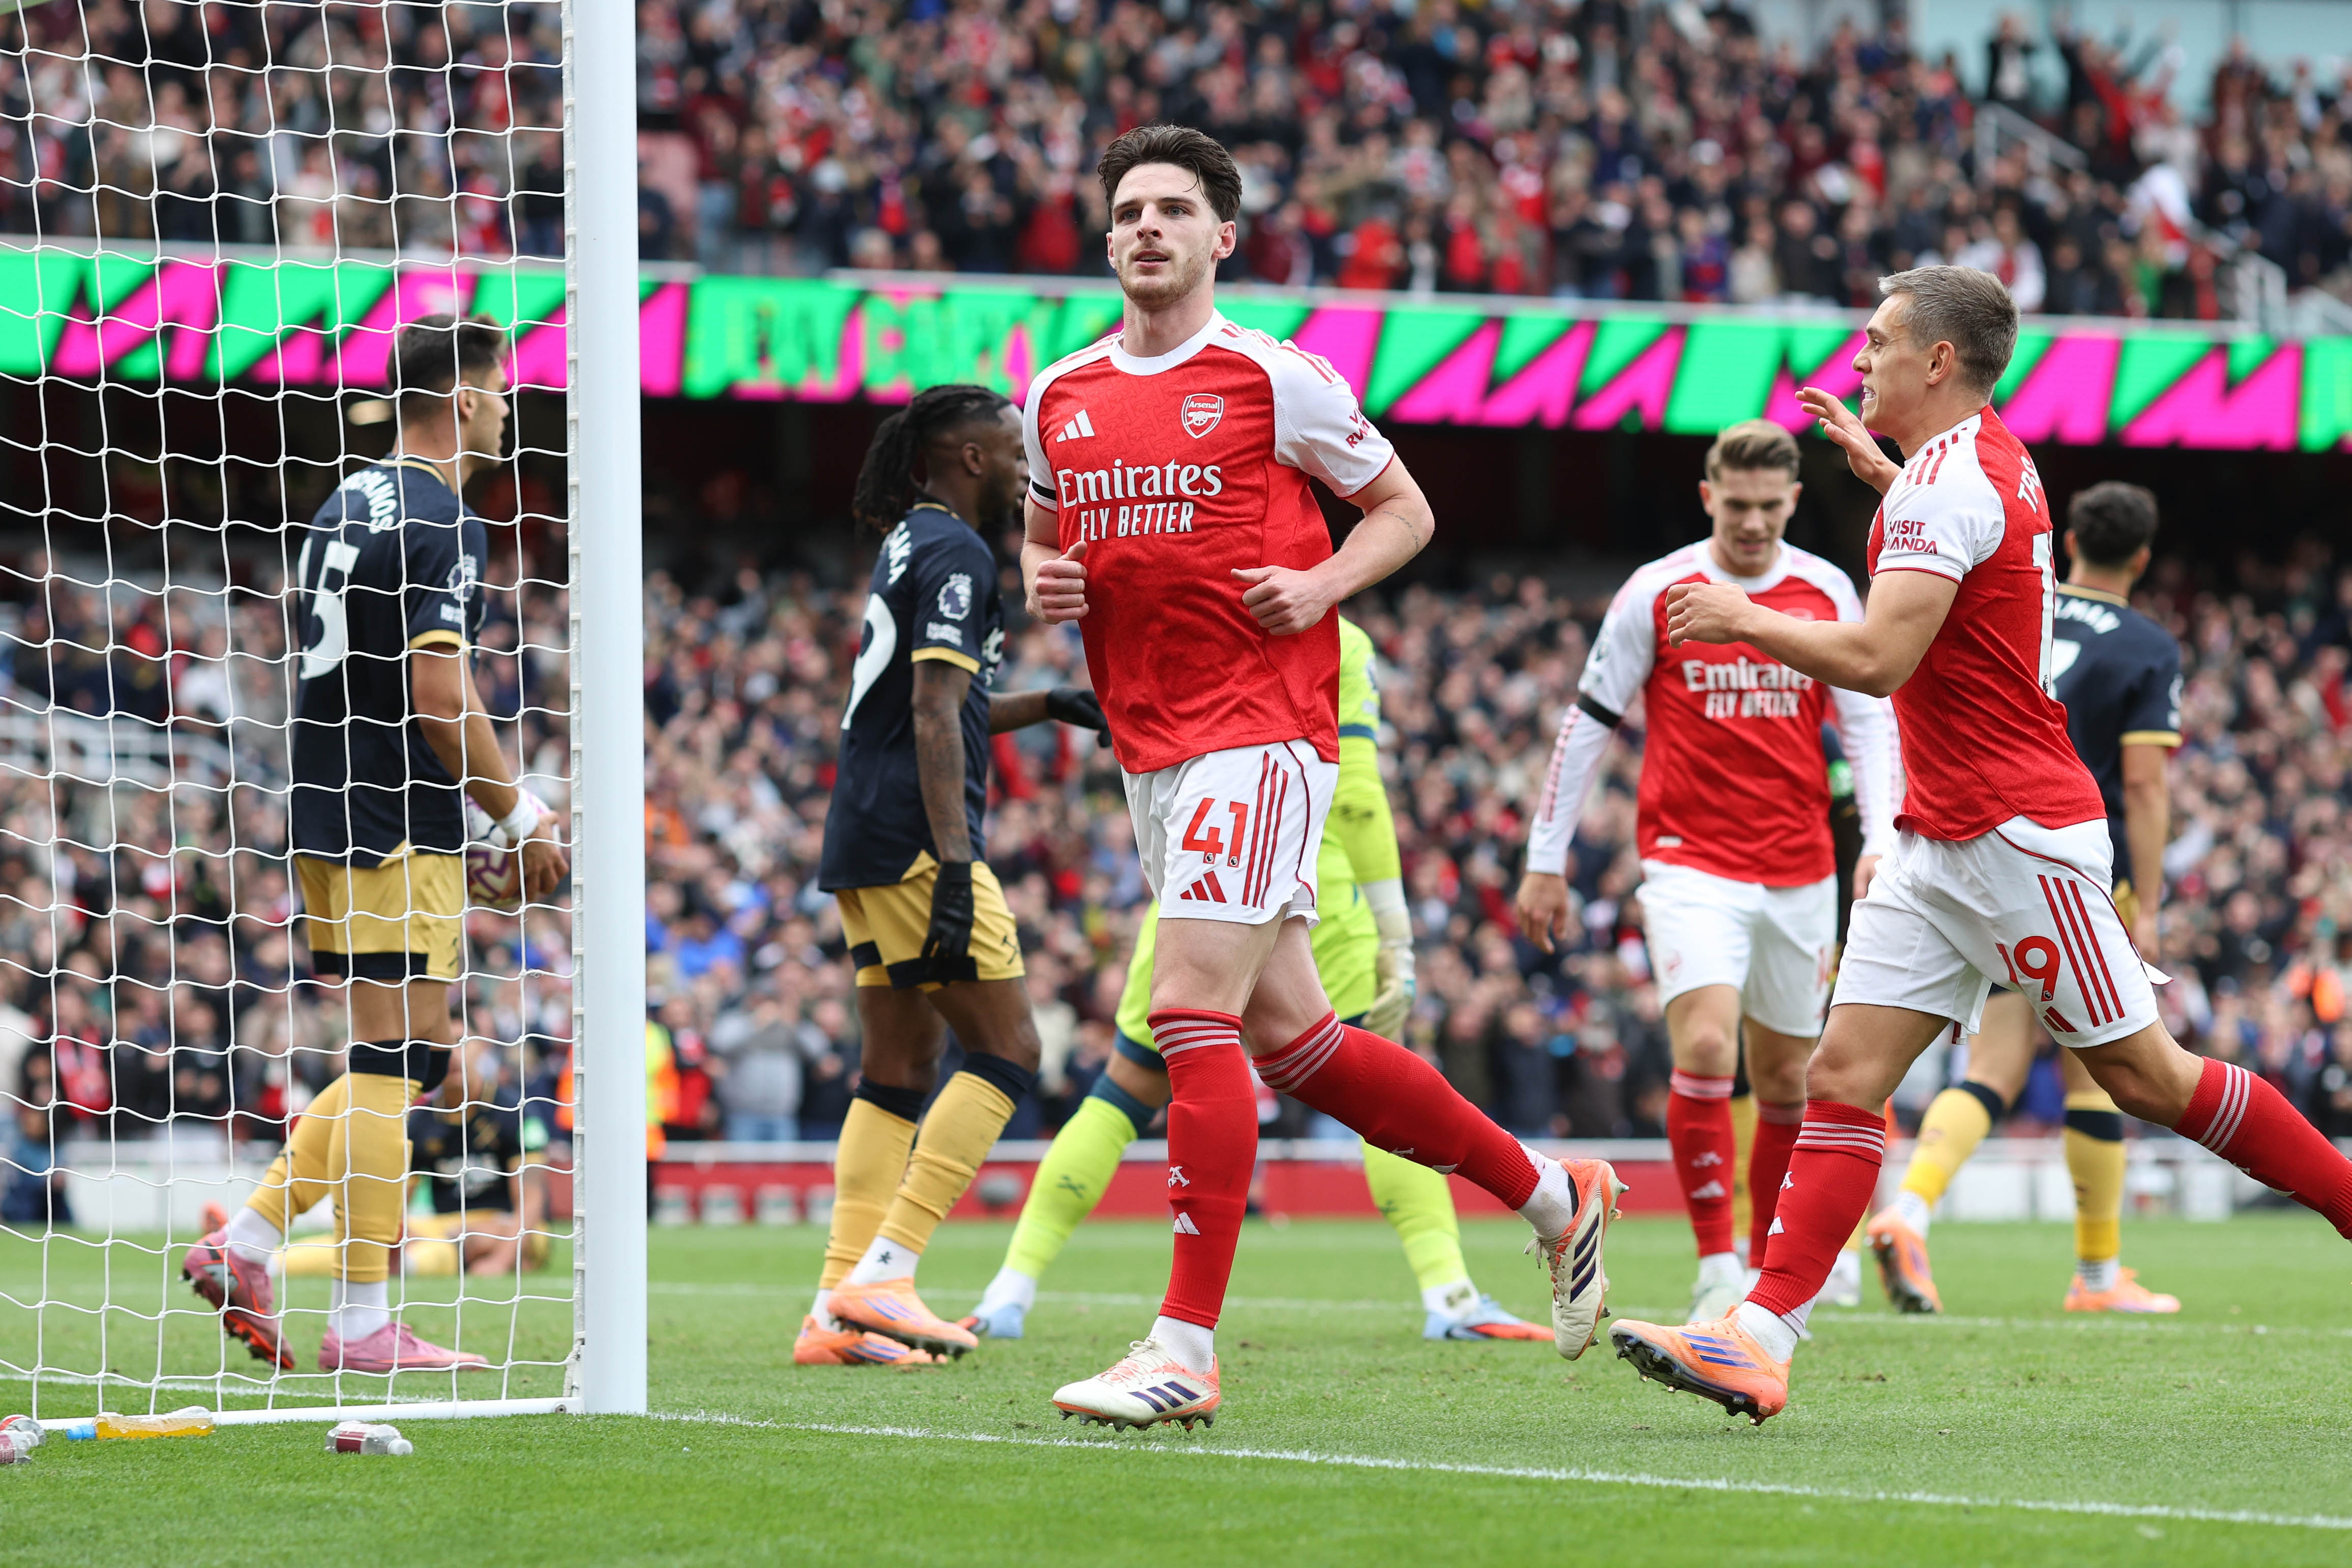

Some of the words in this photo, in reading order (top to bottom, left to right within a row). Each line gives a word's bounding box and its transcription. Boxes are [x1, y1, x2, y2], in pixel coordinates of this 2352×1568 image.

[1189, 400, 1218, 409] Arsenal
[1056, 458, 1222, 508] Emirates
[1080, 508, 1110, 541] FLY
[1117, 502, 1194, 537] BETTER
[1889, 520, 1926, 536] VISIT
[1182, 797, 1248, 868] 41
[1995, 935, 2061, 1002] 19
